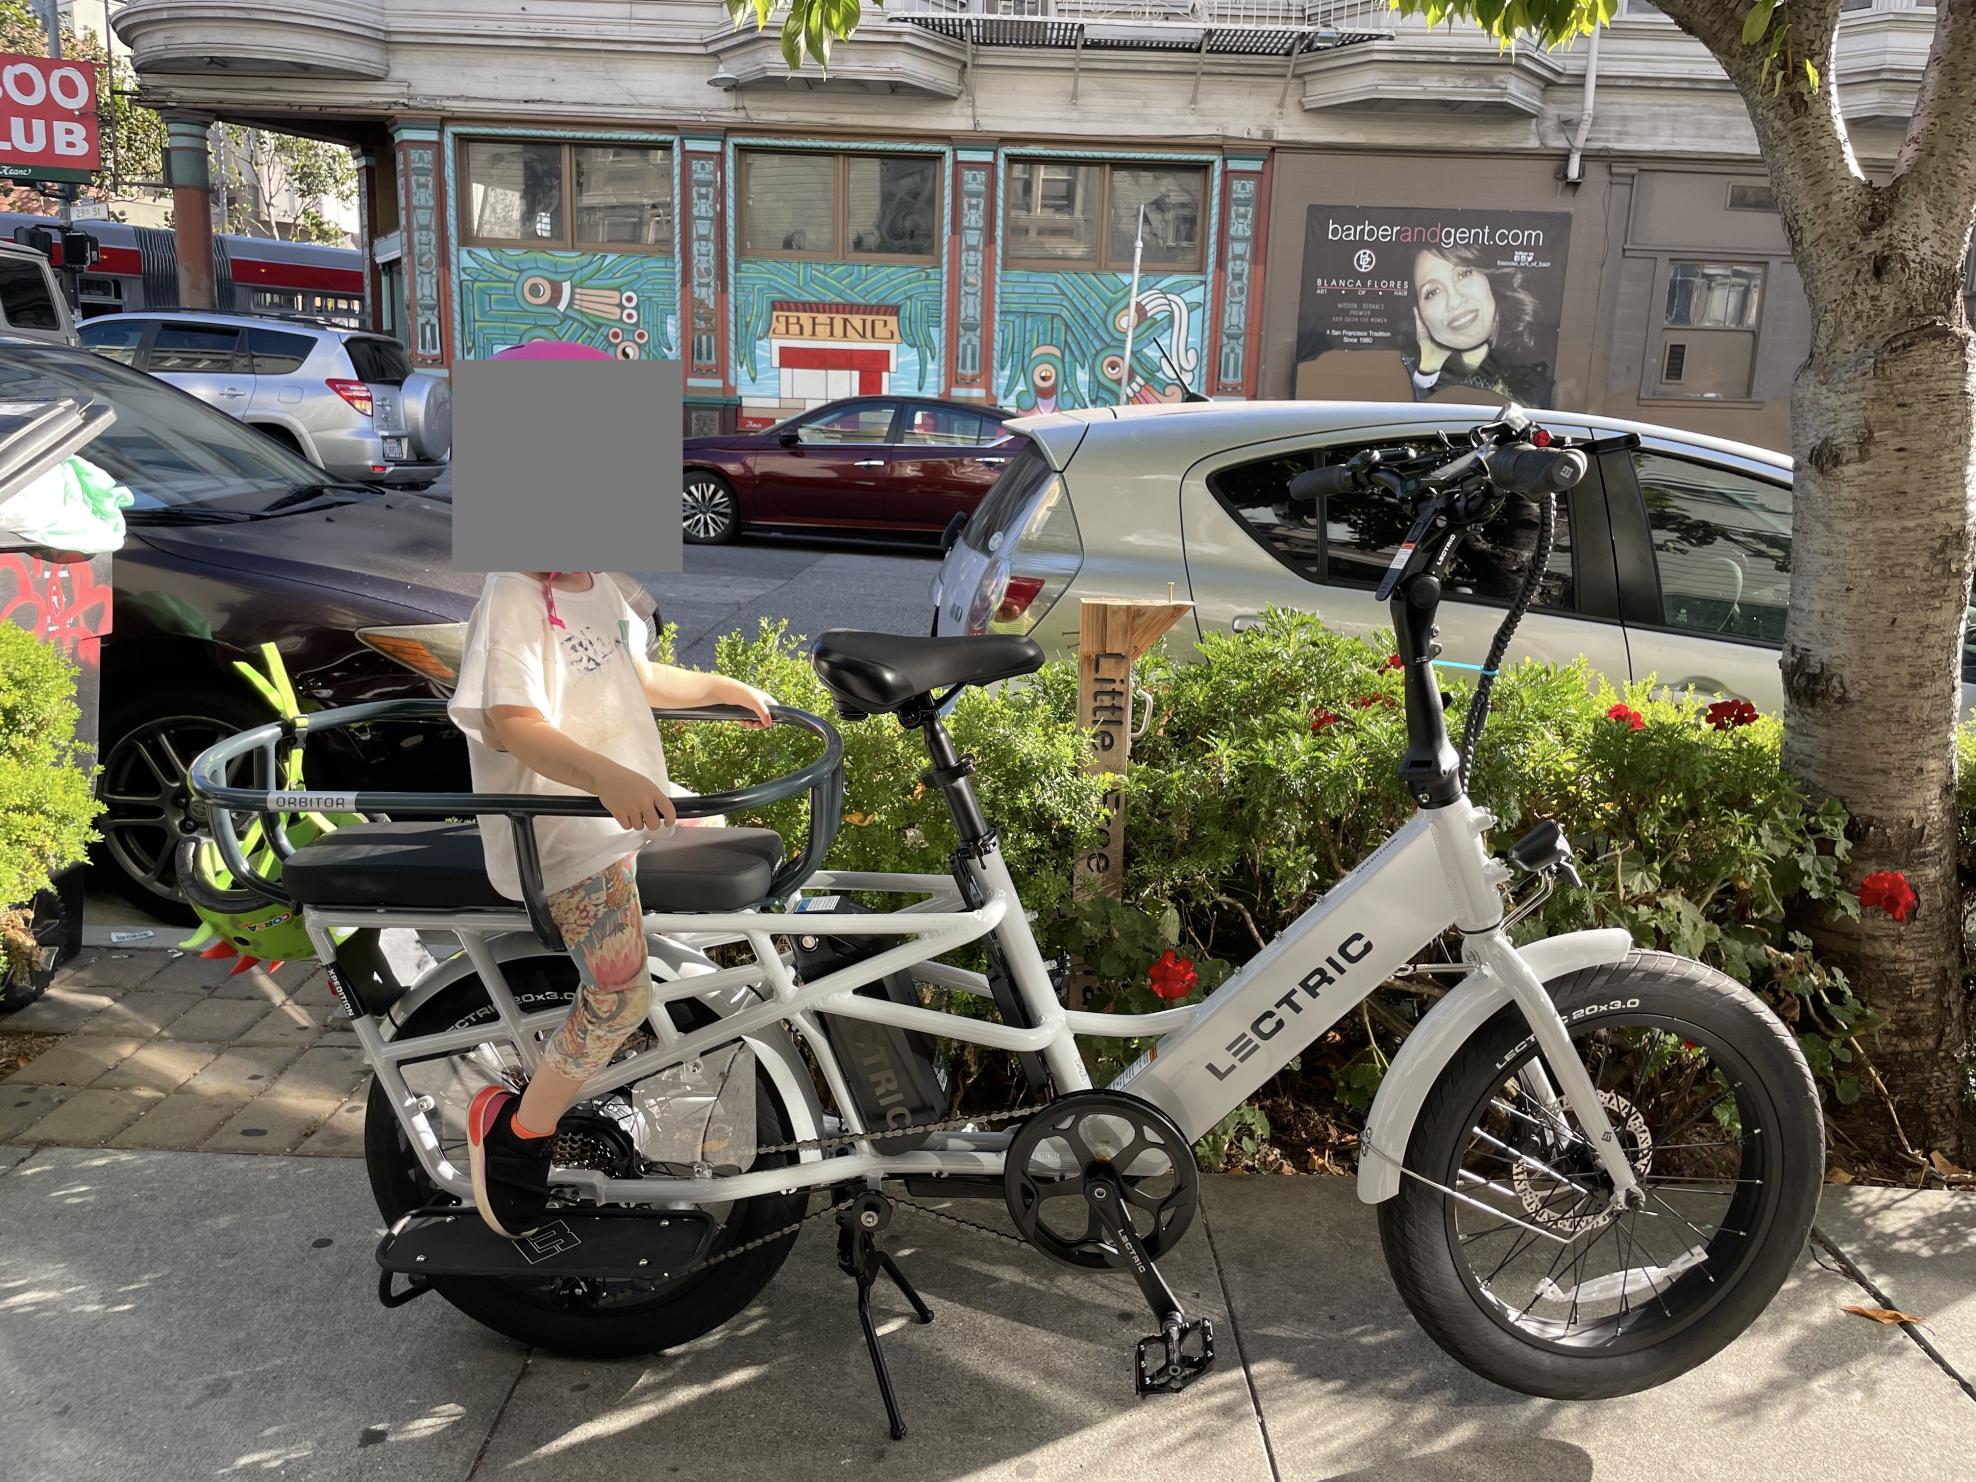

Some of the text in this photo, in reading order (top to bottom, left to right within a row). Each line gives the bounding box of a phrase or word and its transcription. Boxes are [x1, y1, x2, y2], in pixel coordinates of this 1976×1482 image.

[0, 63, 89, 110] OO
[1328, 219, 1543, 248] barberandgent.com
[1317, 279, 1409, 289] BLANCA FLORES
[1437, 533, 1456, 566] LECTRIC
[1092, 653, 1126, 751] Little
[276, 796, 345, 808] ORBITOR
[328, 968, 354, 1016] XPEDITION
[1205, 932, 1373, 1081] LECTRIC
[1572, 999, 1640, 1020] 20x3.0
[1117, 1228, 1146, 1273] LECTRIC
